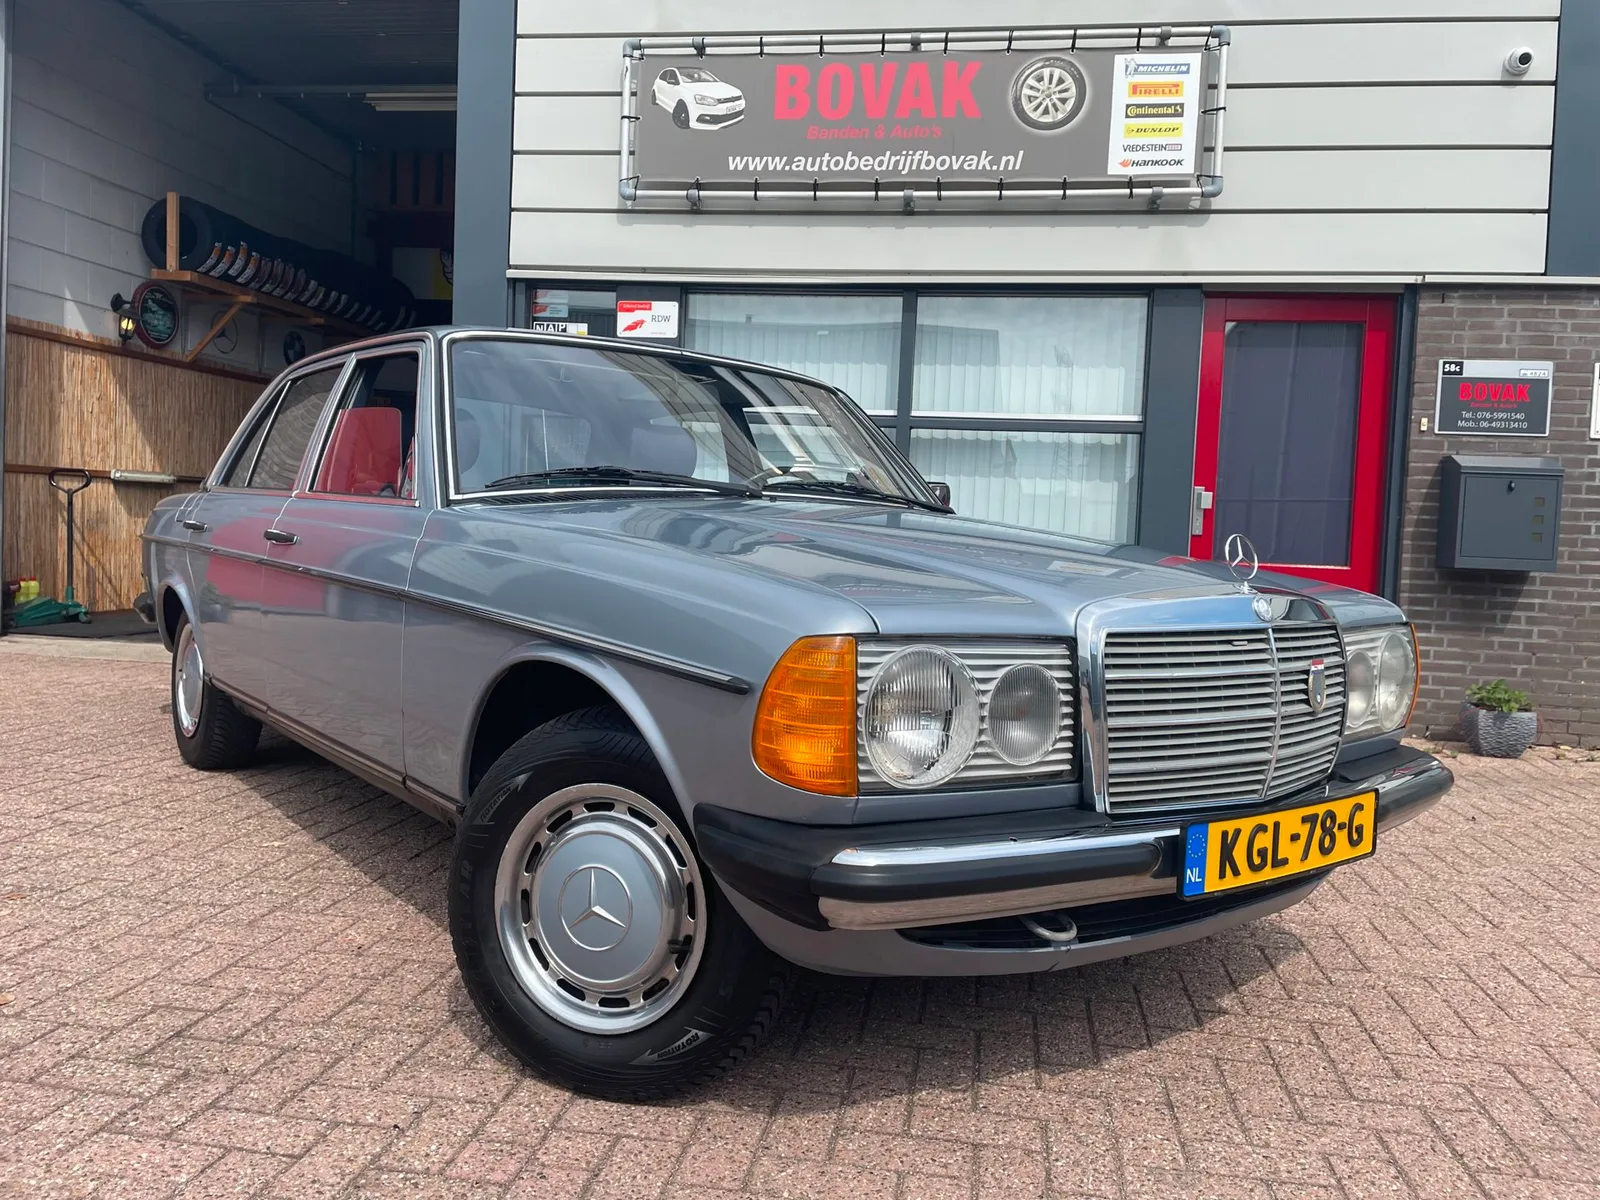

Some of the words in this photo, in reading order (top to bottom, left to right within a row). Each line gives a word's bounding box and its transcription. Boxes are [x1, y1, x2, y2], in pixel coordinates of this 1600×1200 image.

[773, 61, 984, 121] BOVAK
[1132, 84, 1179, 95] PIRELLI
[1127, 105, 1175, 117] Continental
[806, 125, 869, 140] Banden
[874, 124, 885, 139] &
[890, 124, 942, 139] Auto's
[1122, 144, 1167, 153] VREDESTEIN
[727, 150, 1024, 174] www.autobedrijfbovak.nl
[651, 314, 672, 323] RDW
[535, 323, 566, 332] NAP
[1458, 381, 1531, 403] BOVAK
[1461, 411, 1476, 419] Tel.:
[1477, 411, 1525, 420] 076-5991540
[1457, 420, 1479, 428] Mob.:
[1480, 420, 1528, 429] 06-49313410
[1218, 802, 1365, 880] KGL-78-G
[1186, 867, 1203, 884] NL
[656, 1032, 700, 1059] ROTATION
